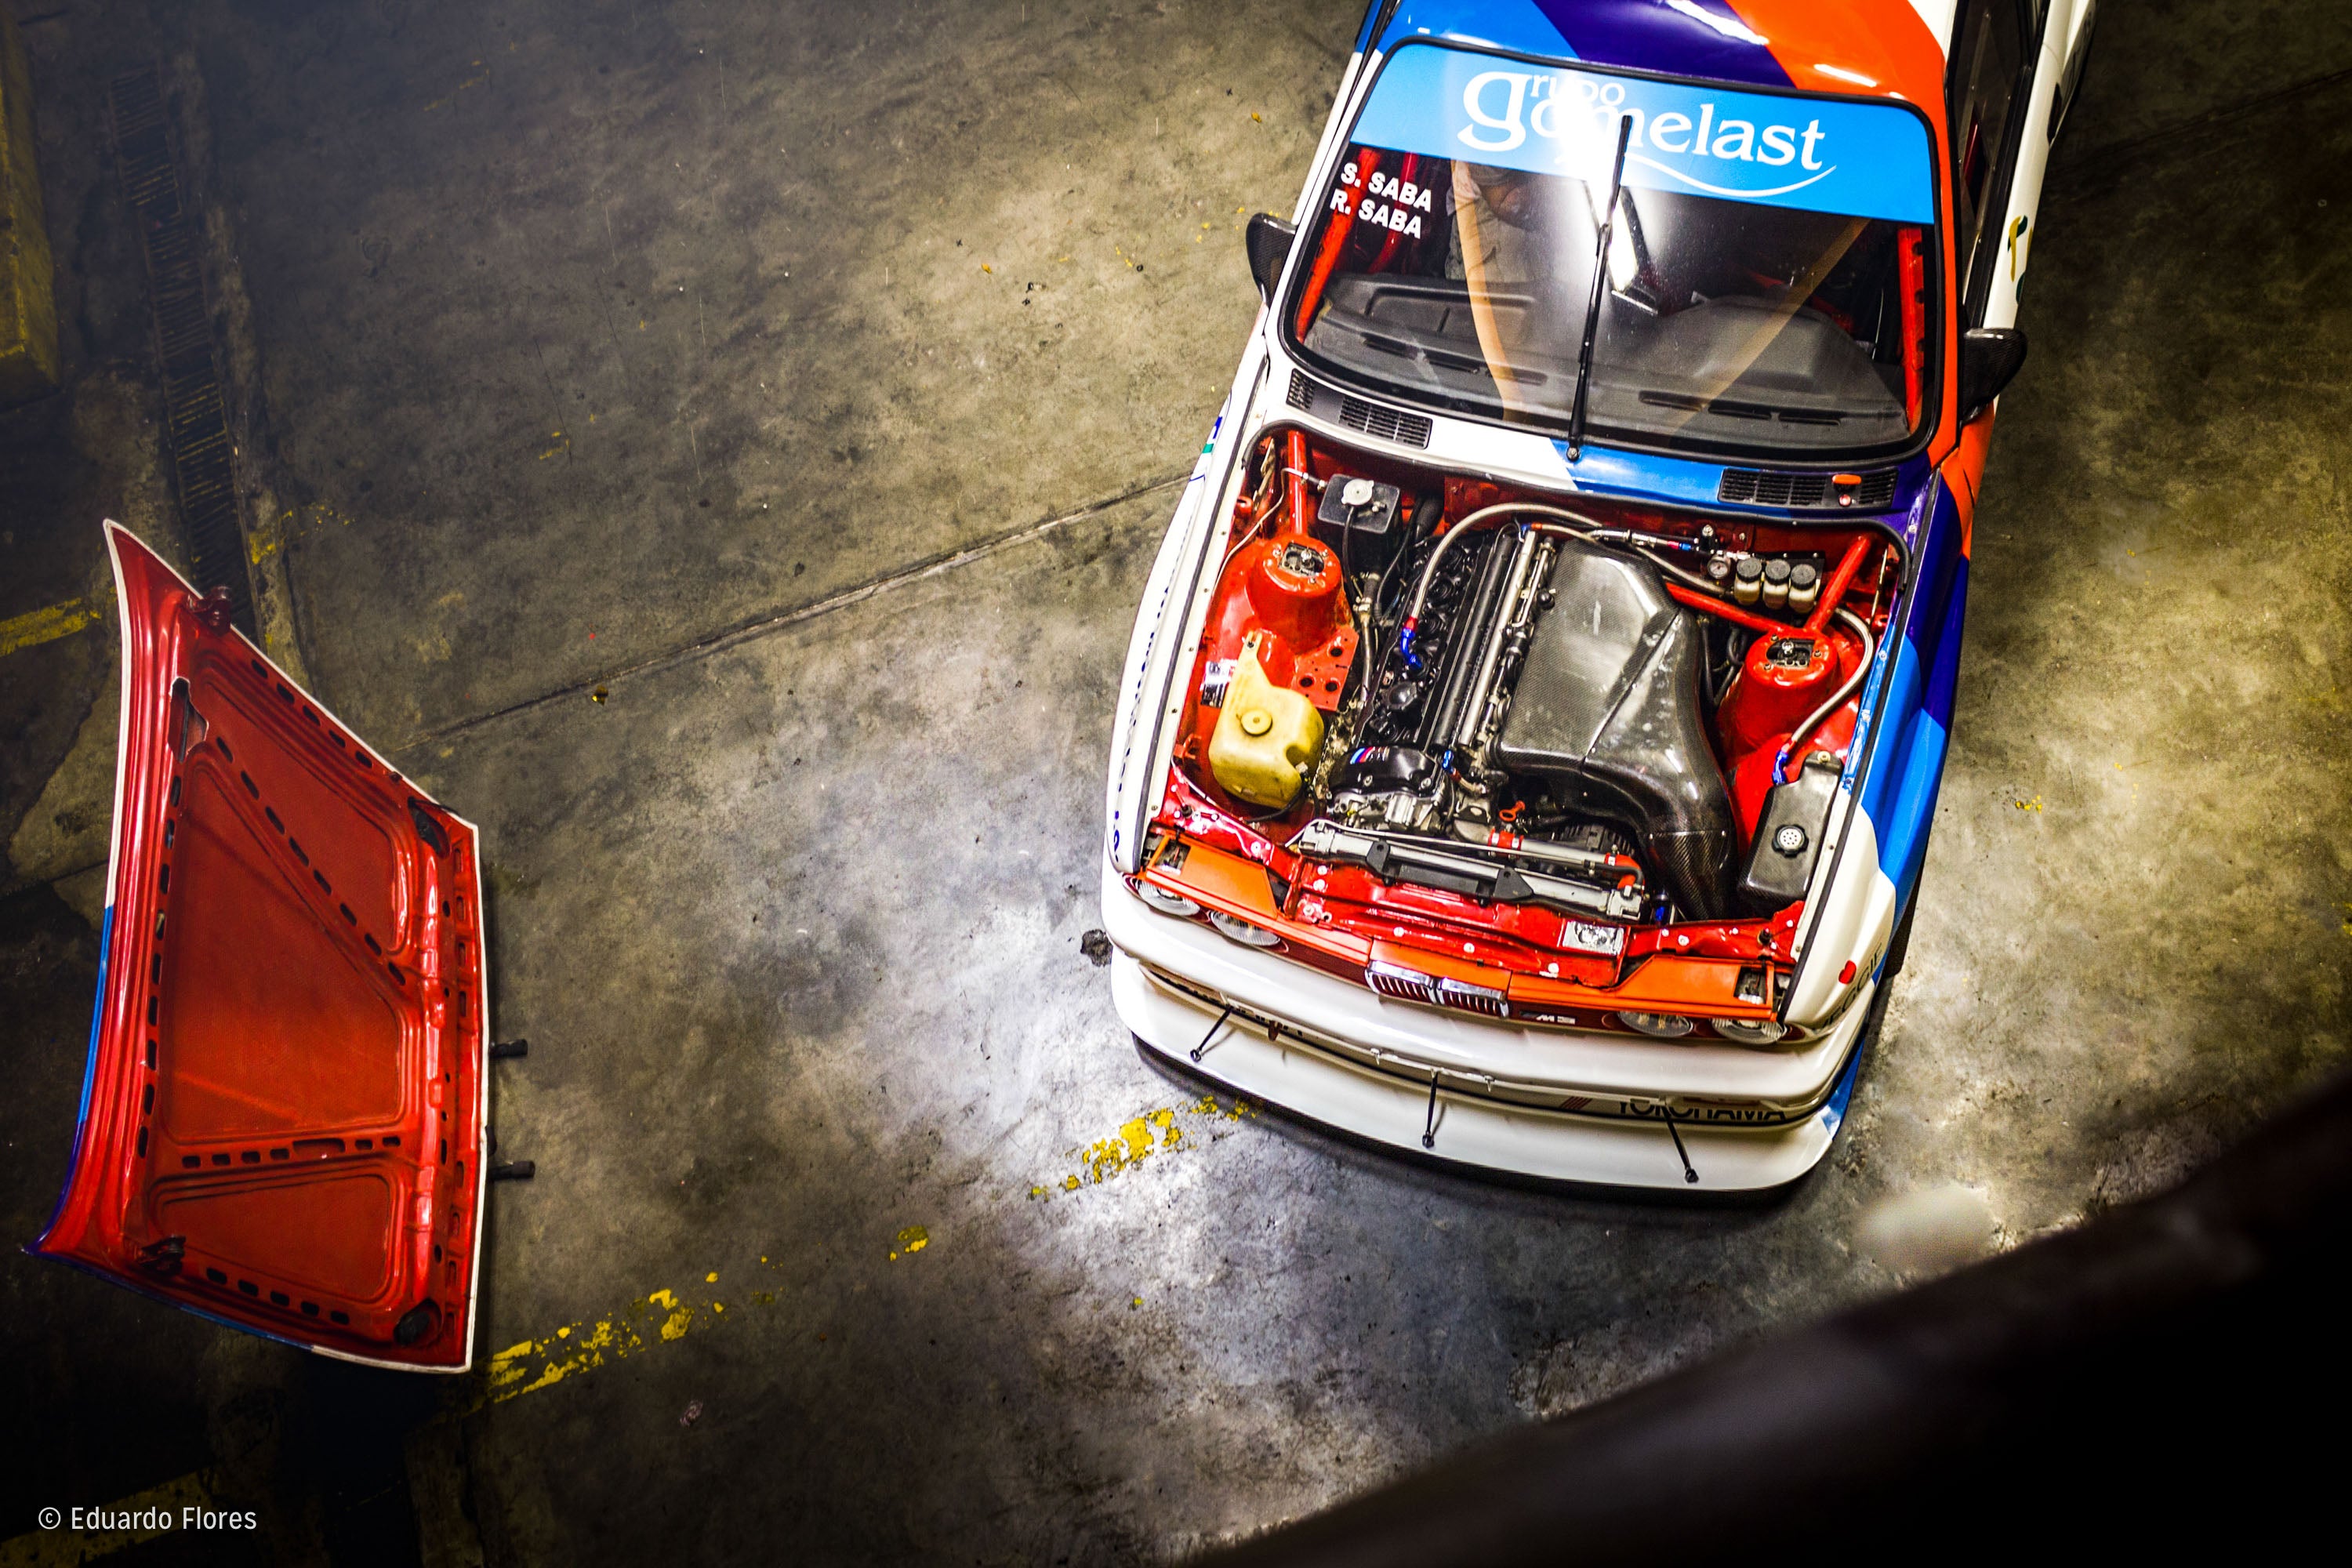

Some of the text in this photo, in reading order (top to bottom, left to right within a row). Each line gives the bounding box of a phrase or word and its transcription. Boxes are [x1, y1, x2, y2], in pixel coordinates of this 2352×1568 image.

[1341, 162, 1432, 213] S. SABA
[1330, 188, 1421, 239] R. SABA
